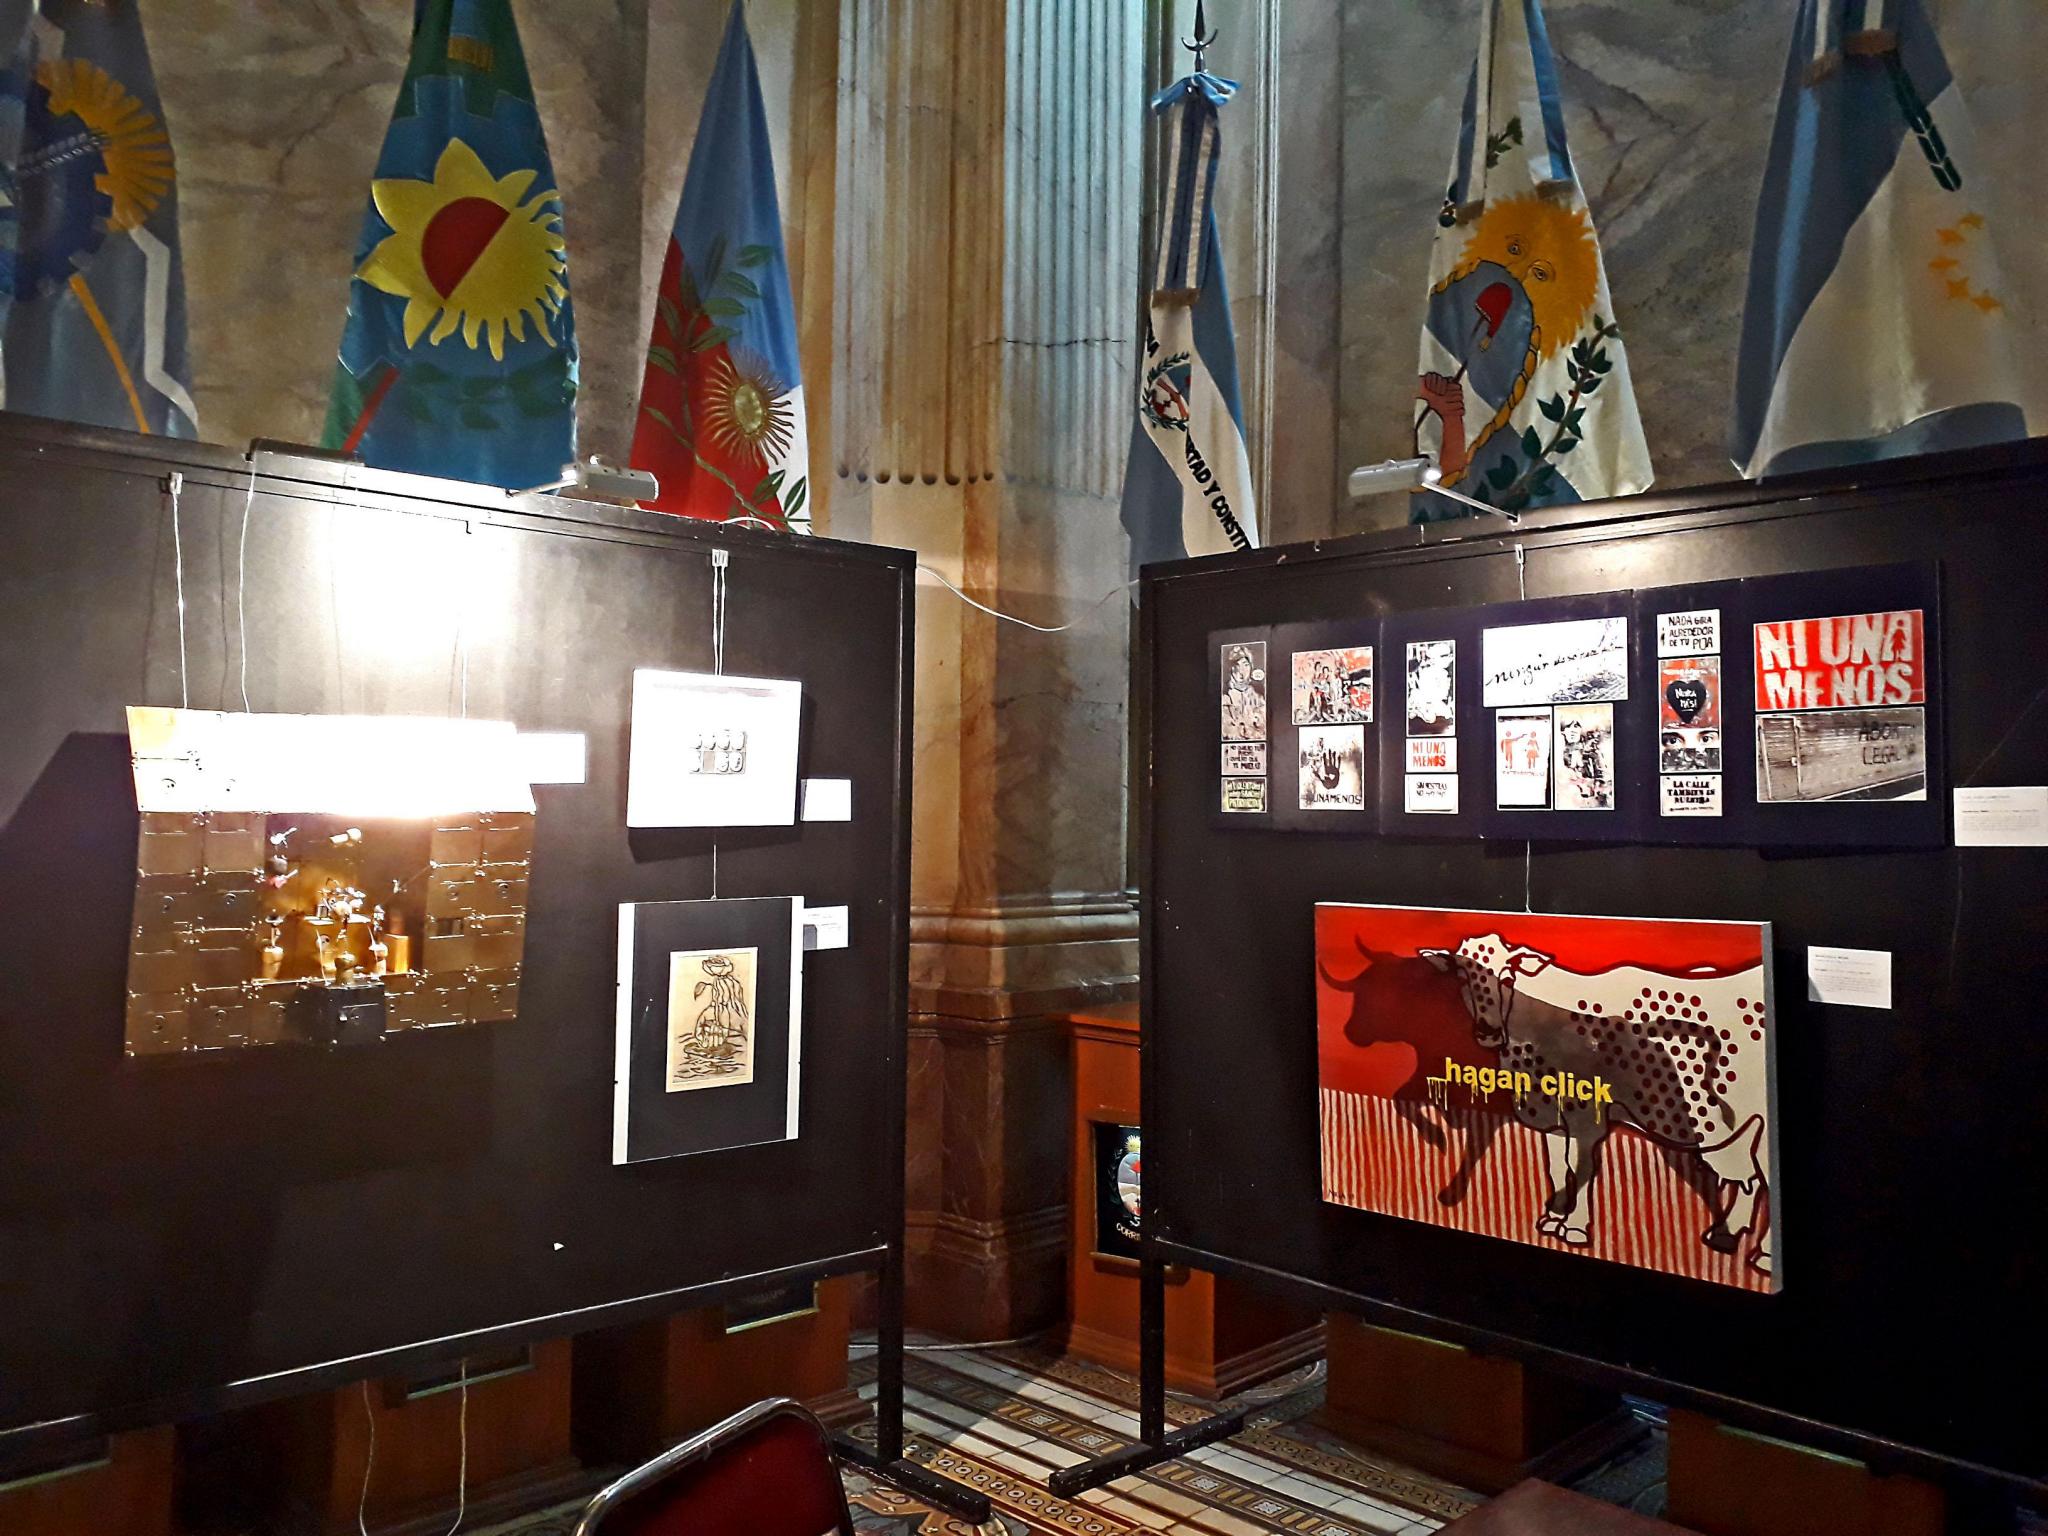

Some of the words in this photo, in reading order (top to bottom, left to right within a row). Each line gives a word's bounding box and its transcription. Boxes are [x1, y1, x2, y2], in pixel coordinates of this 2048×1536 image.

[1203, 480, 1221, 497] Y
[1668, 615, 1693, 626] NADA
[1669, 626, 1713, 638] ALREDEDOR
[1669, 639, 1678, 647] DE
[1680, 638, 1690, 646] TU
[1758, 622, 1807, 670] NI
[1819, 612, 1913, 665] UNA
[1765, 663, 1913, 709] MENOS
[1412, 741, 1423, 754] NI
[1426, 741, 1447, 754] UNA
[1412, 755, 1447, 767] MENOS
[1673, 780, 1684, 788] LA
[1686, 780, 1710, 788] CALLE
[1445, 1056, 1531, 1094] hagan
[1540, 1071, 1613, 1104] click
